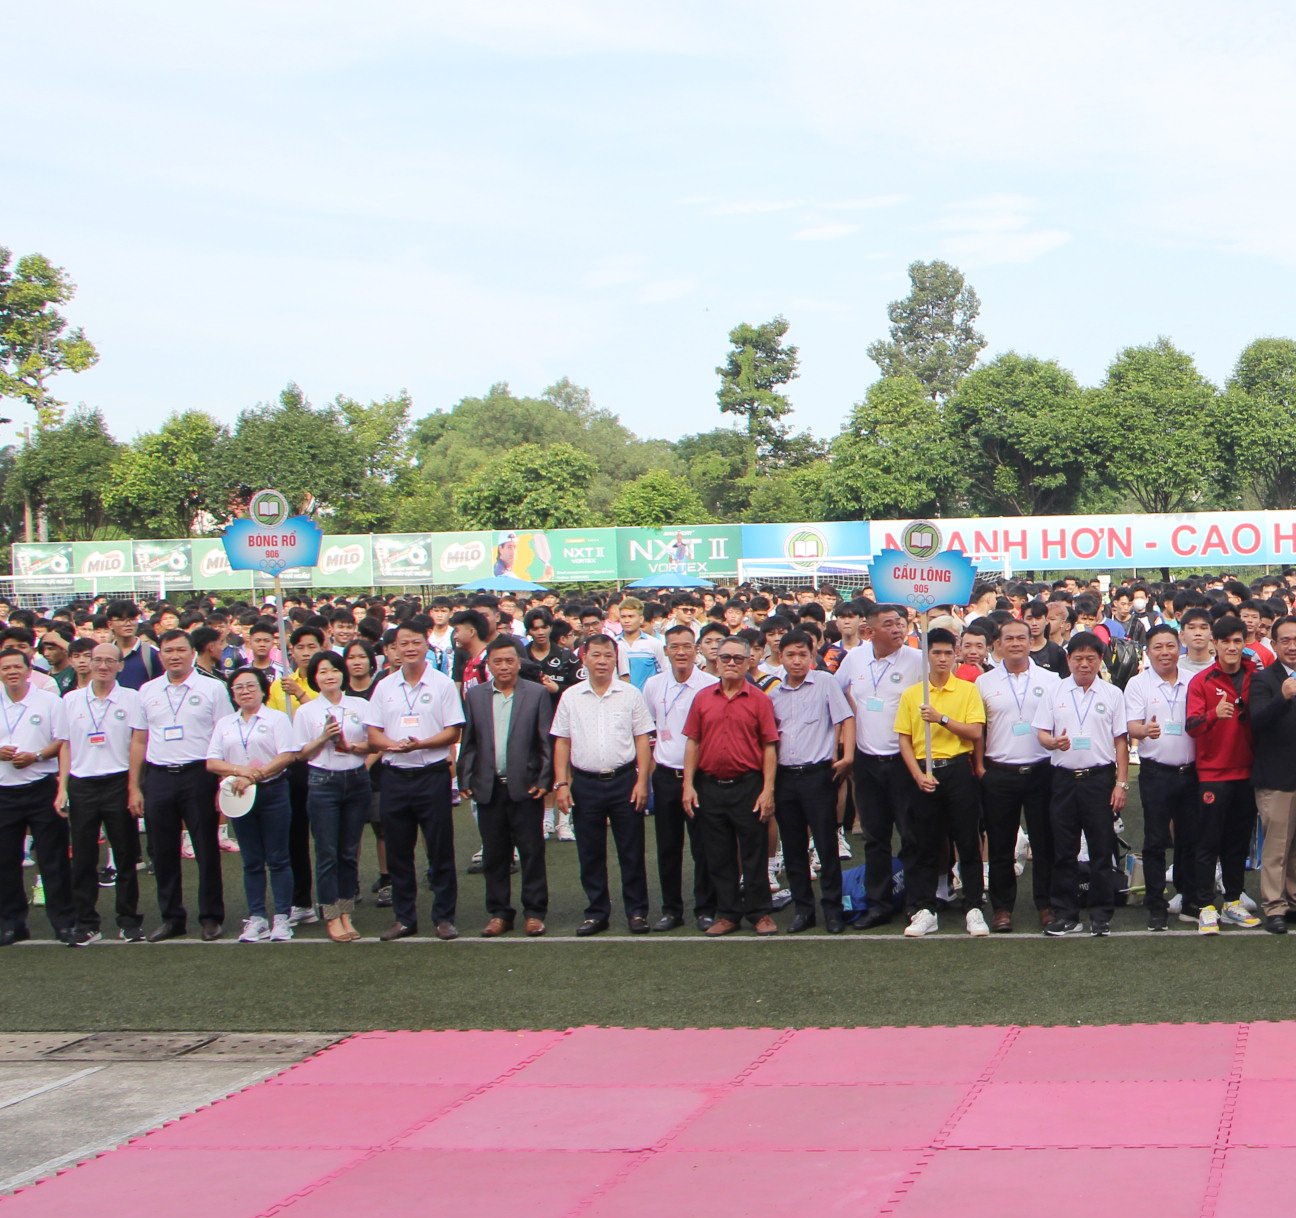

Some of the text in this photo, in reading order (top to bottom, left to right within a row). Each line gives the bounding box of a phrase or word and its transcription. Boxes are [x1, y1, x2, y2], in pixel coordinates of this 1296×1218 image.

[248, 533, 278, 547] BÓNG
[884, 529, 1029, 561] NANH
[1041, 526, 1133, 560] HƠN
[1145, 541, 1157, 549] -
[1171, 522, 1263, 556] CAO
[265, 550, 280, 558] 906
[446, 548, 482, 564] MILO
[563, 546, 605, 558] NXT II
[629, 537, 729, 561] NXT II
[87, 558, 122, 573] MILO
[206, 556, 231, 570] MIL
[326, 551, 361, 567] MILO
[648, 561, 708, 574] VORTEX
[920, 566, 952, 583] LÔNG
[913, 584, 929, 593] 905
